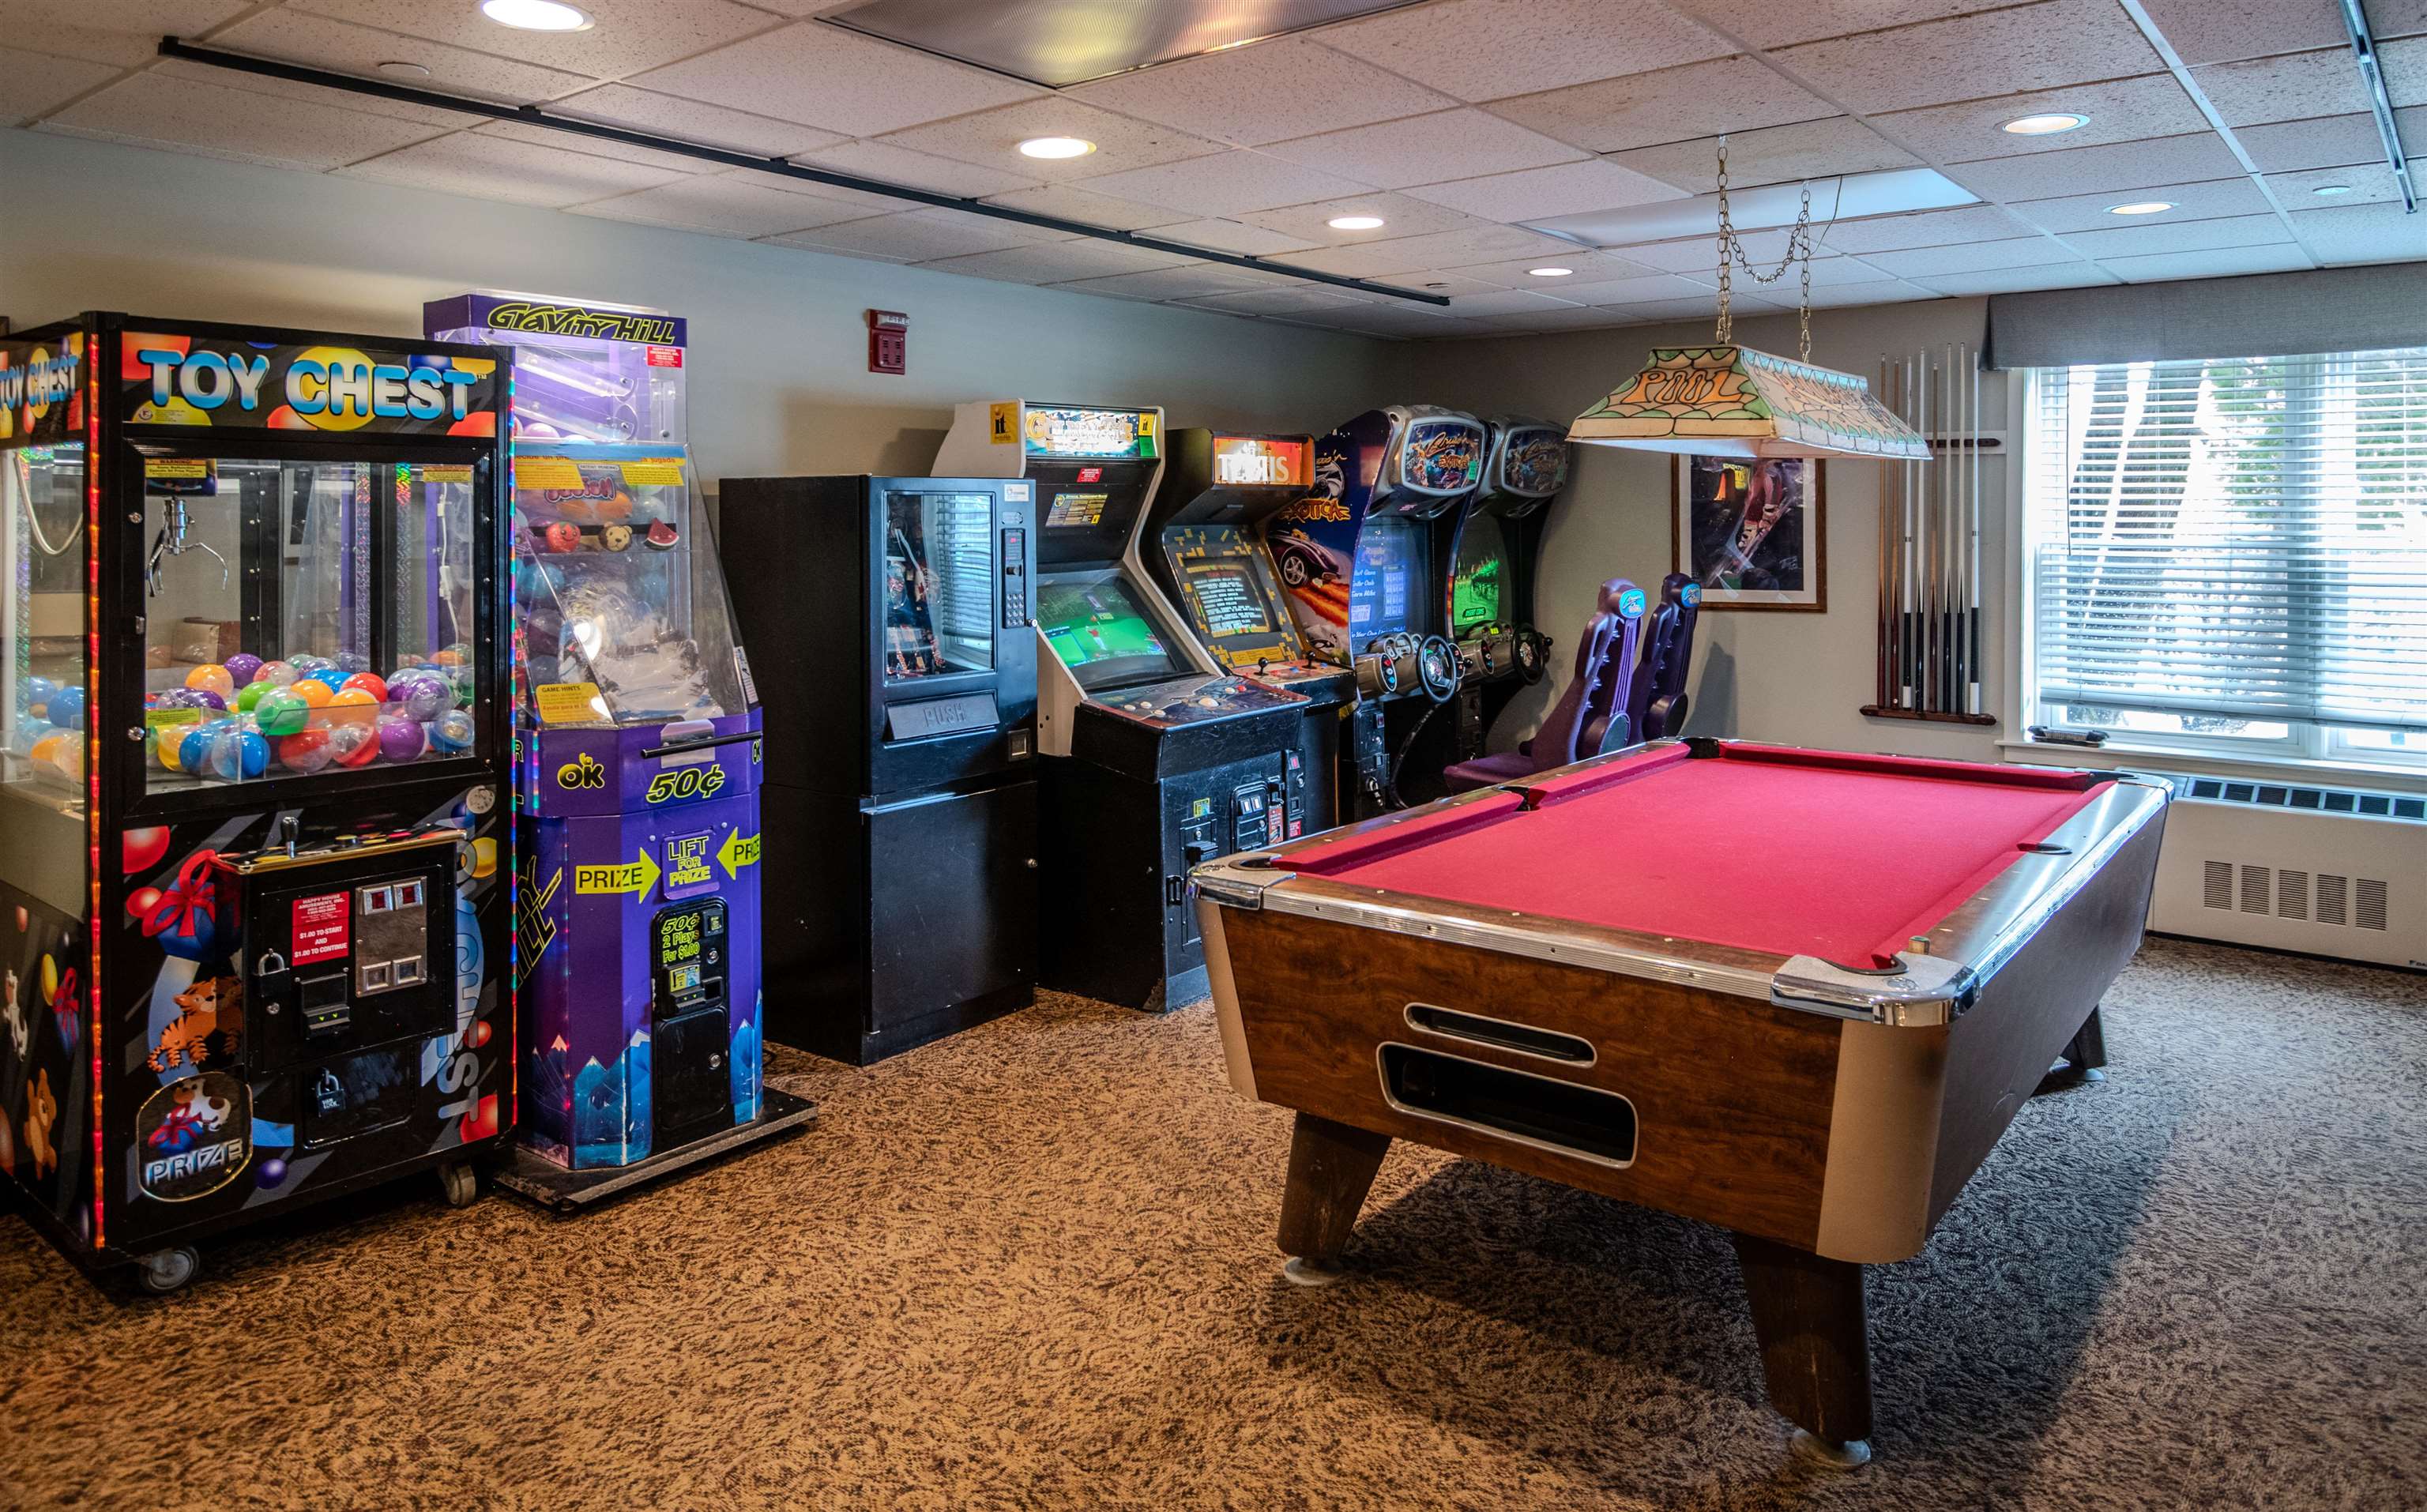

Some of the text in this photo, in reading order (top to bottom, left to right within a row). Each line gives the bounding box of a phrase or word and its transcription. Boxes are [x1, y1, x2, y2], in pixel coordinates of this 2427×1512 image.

[27, 355, 79, 407] CHEST
[139, 349, 269, 411] TOY
[285, 359, 477, 421] CHEST
[1620, 369, 1743, 404] POOL
[1217, 453, 1289, 483] TRIS
[923, 701, 966, 728] PUSH
[645, 764, 725, 803] 50¢
[668, 836, 709, 861] LIFT
[678, 856, 702, 871] FOR
[579, 867, 642, 889] PRIZE
[669, 866, 711, 887] PRIZE
[299, 931, 315, 939] $1.00
[325, 926, 343, 935] START
[661, 913, 700, 935] 50¢
[294, 950, 310, 958] $1.00
[319, 942, 348, 953] CONTINUE
[663, 929, 700, 949] 2 Plays
[663, 942, 701, 964] For $1.00
[145, 1138, 243, 1186] PRIZE
